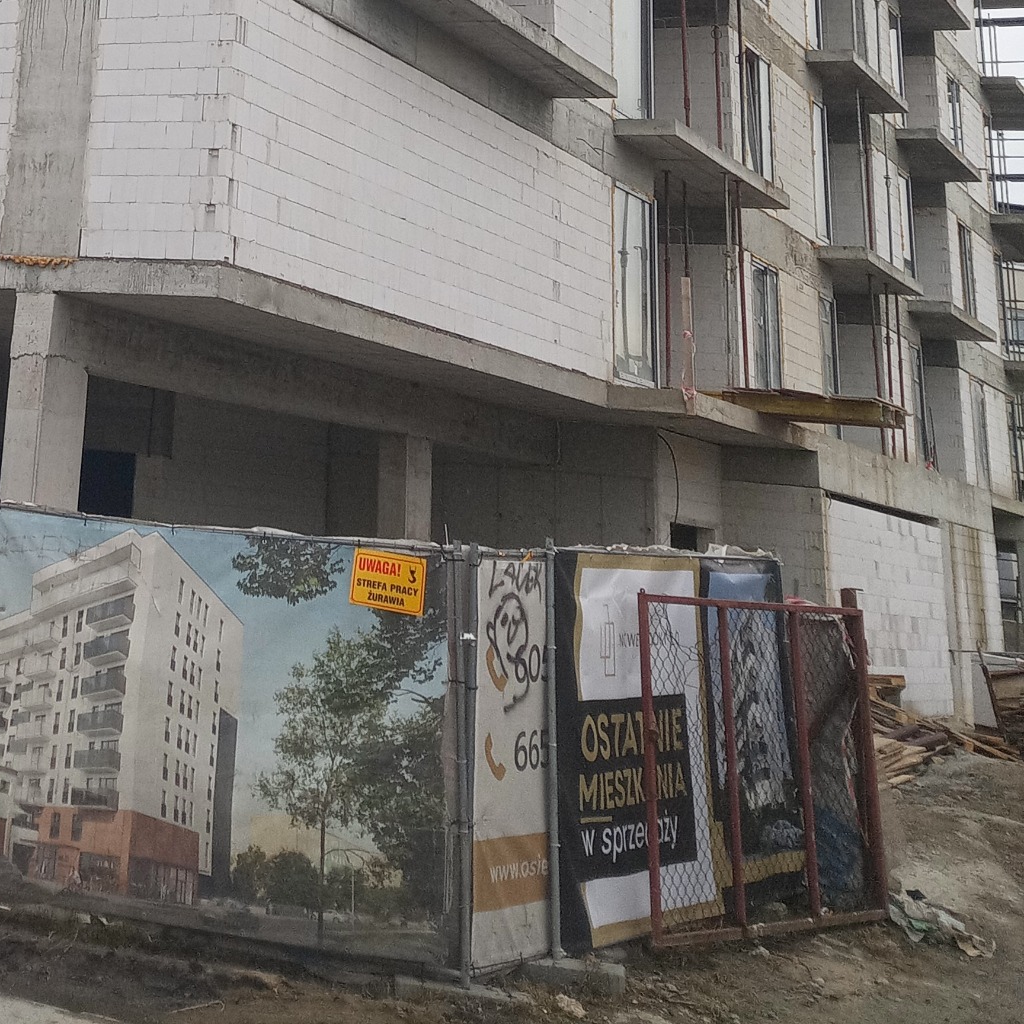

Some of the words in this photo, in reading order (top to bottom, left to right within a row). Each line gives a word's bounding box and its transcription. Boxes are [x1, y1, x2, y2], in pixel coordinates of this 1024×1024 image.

[358, 557, 401, 577] UWAGA!
[356, 578, 387, 592] STREFA
[390, 584, 419, 597] PRACY
[367, 590, 405, 607] ŻURAWIA
[579, 761, 688, 812] MIESZKNIA
